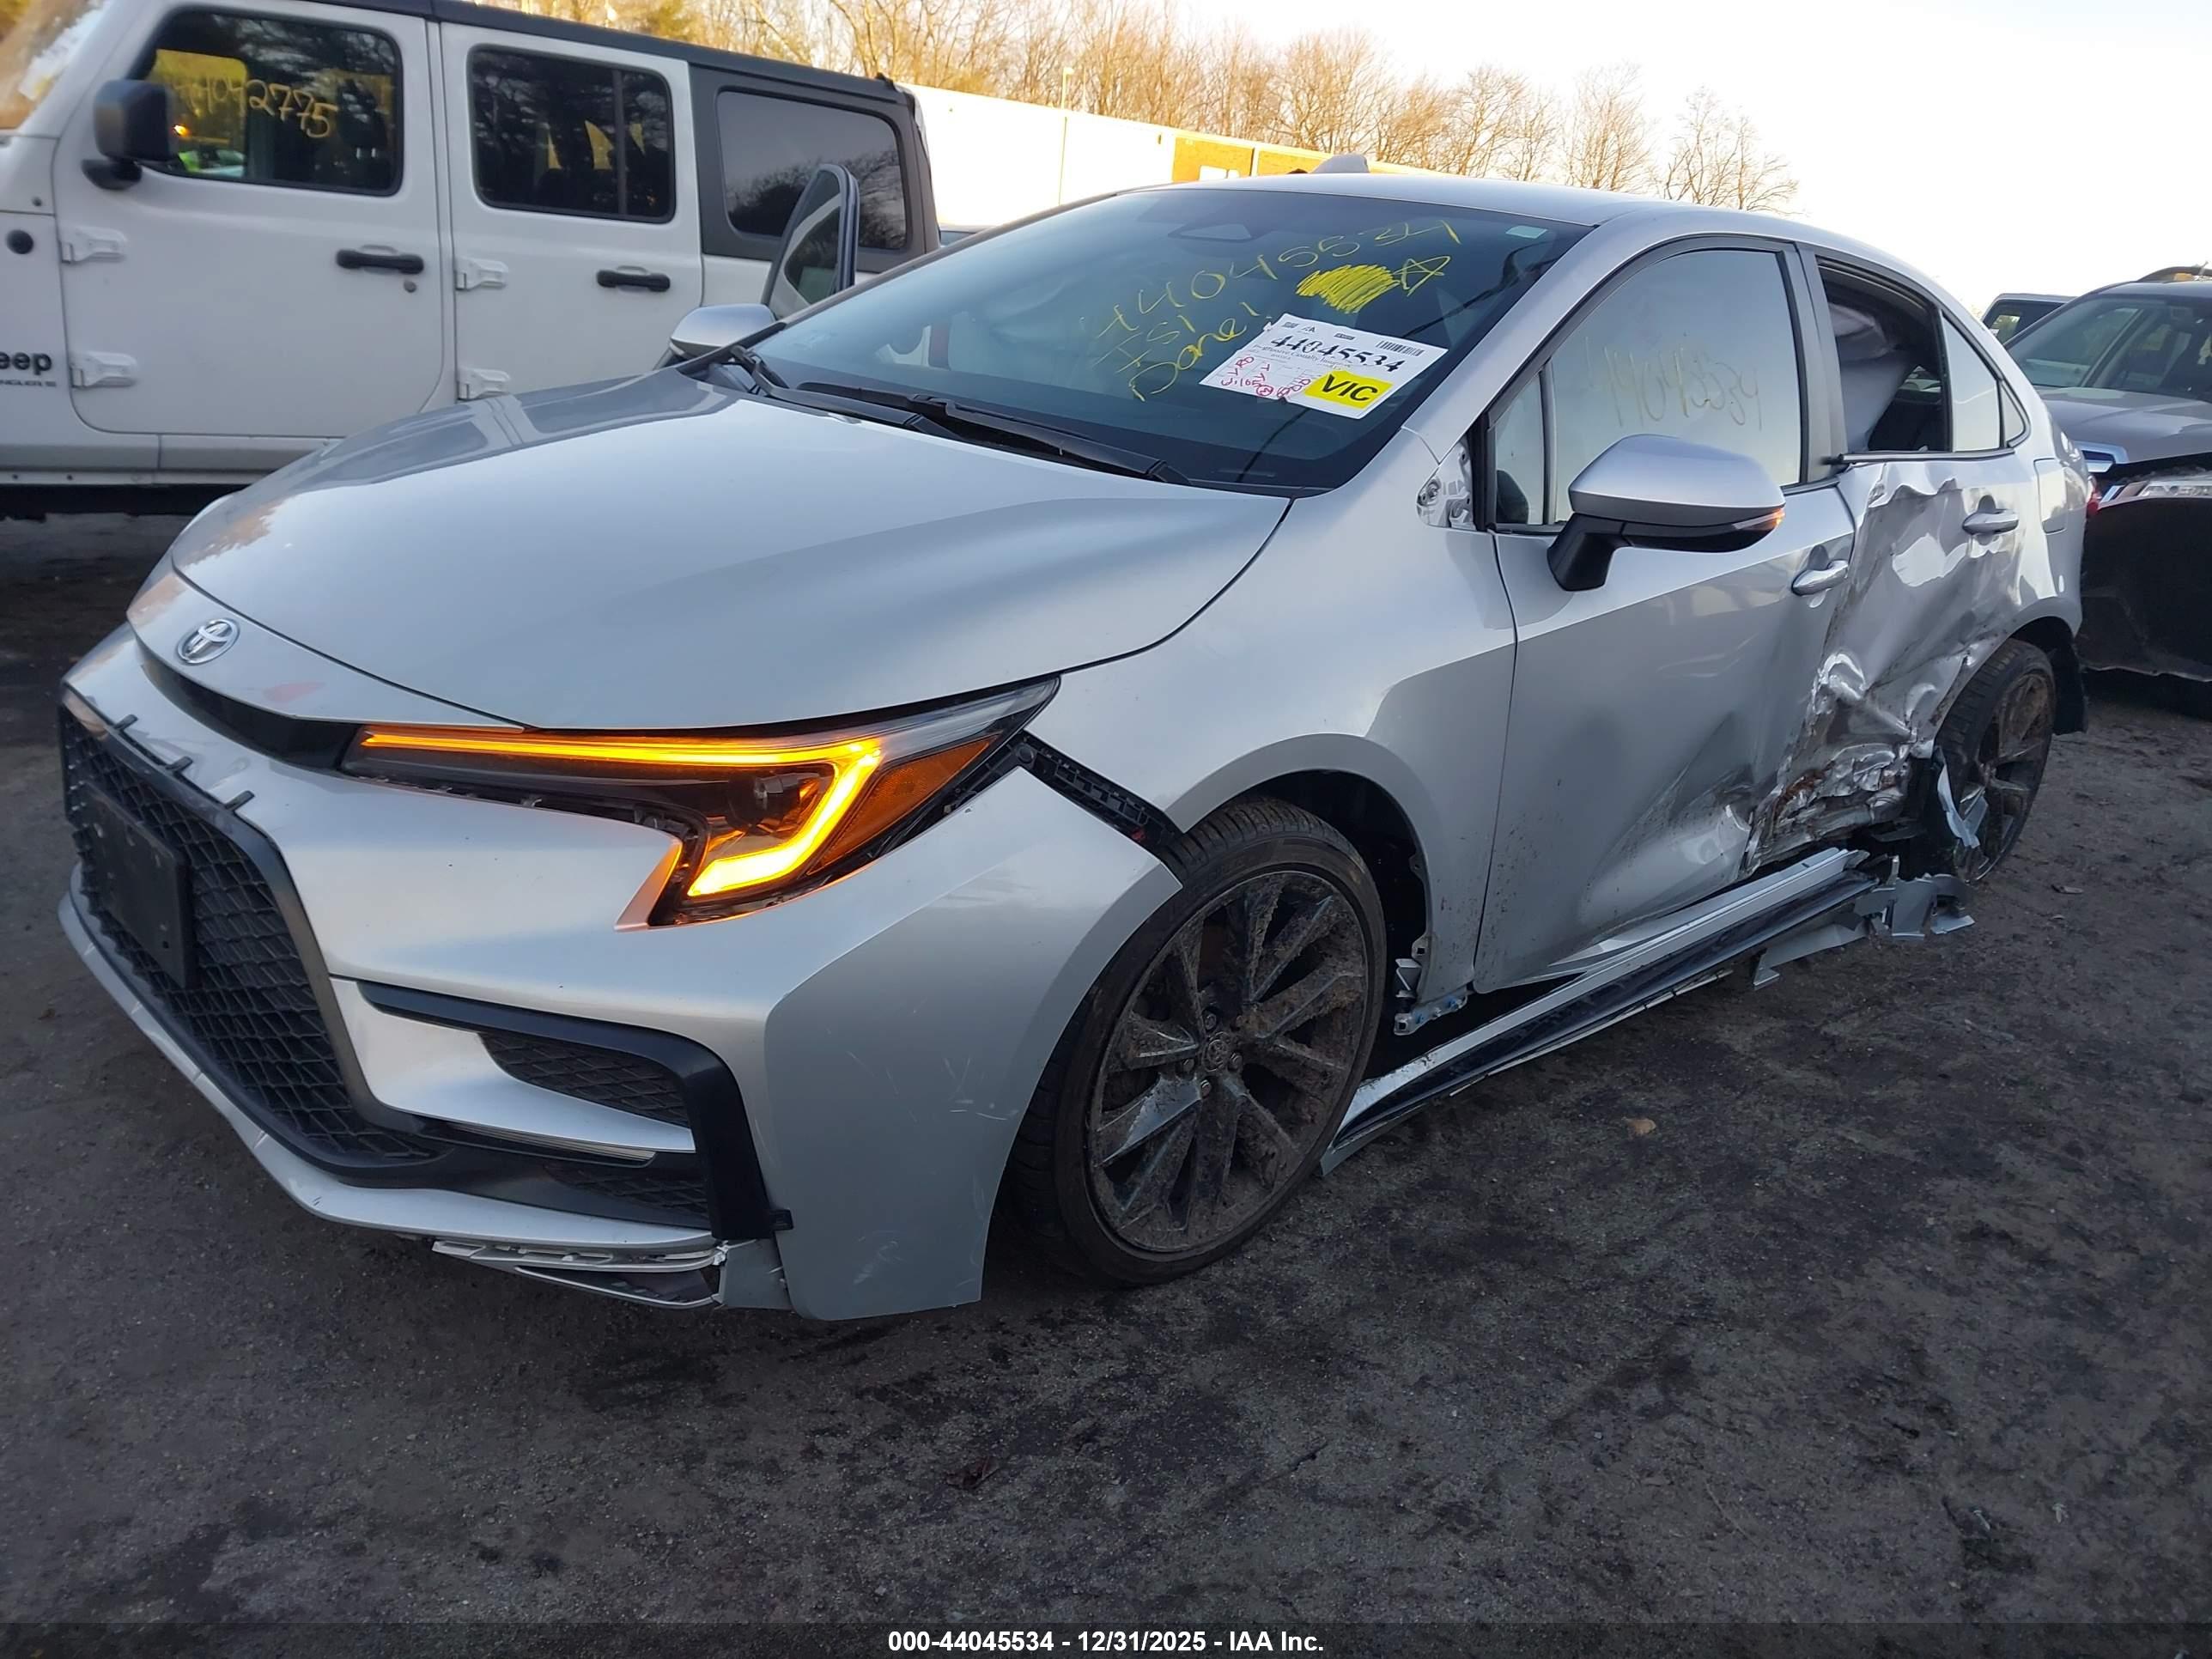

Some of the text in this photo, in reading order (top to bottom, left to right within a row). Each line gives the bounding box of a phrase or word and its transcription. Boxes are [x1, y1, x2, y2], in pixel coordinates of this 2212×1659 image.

[0, 351, 52, 375] eep
[1271, 334, 1406, 373] 44045534
[1321, 373, 1379, 402] VIC
